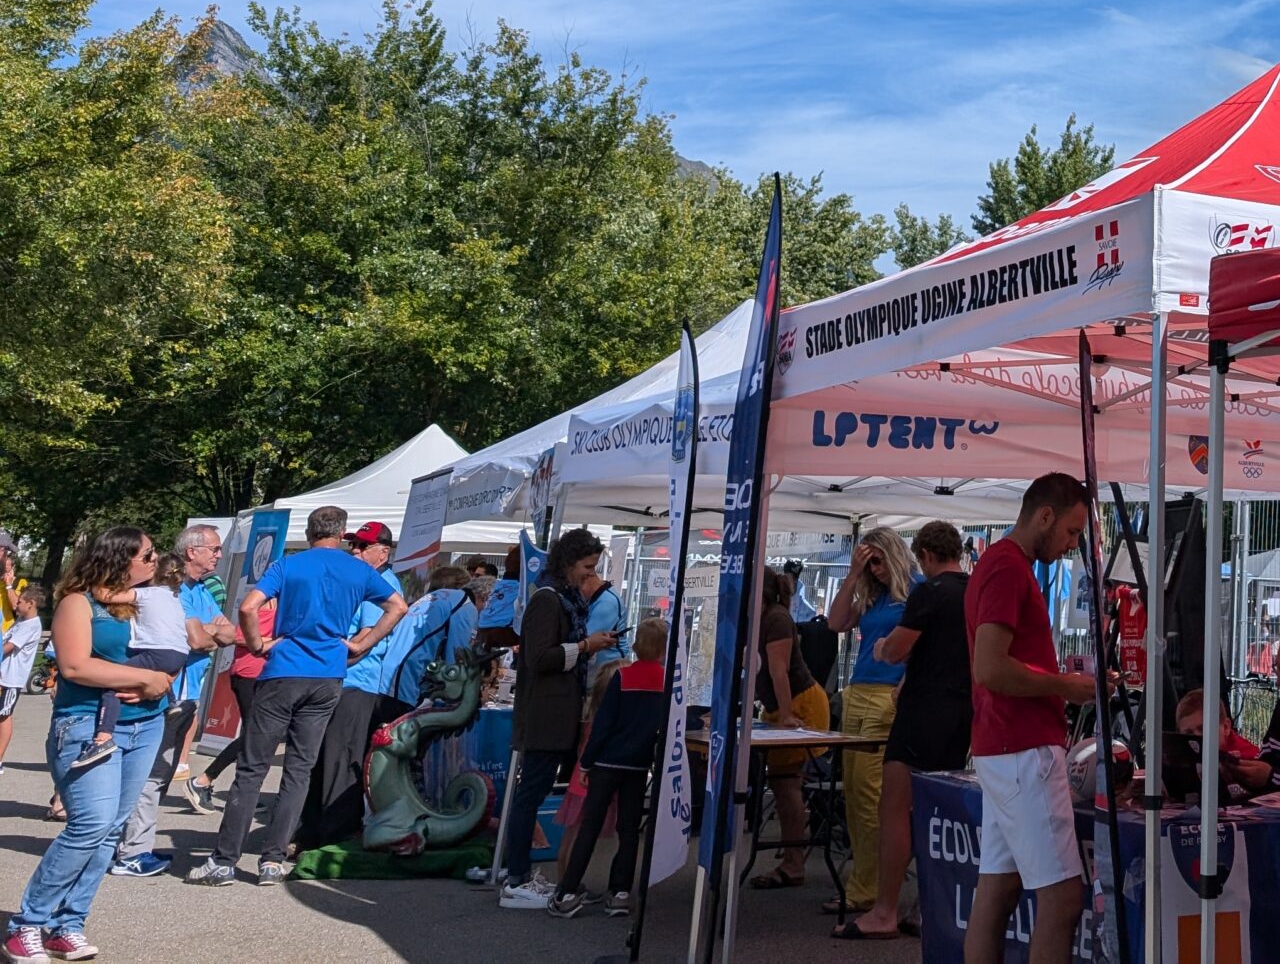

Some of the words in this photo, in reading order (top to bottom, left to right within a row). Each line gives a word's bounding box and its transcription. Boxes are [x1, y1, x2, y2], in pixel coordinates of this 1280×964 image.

[1098, 238, 1118, 252] SAVOIE
[805, 317, 843, 359] STADE
[845, 292, 918, 347] OLYMPIQUE
[920, 278, 966, 325] UGINE
[966, 245, 1078, 312] ALBERTVILLE
[571, 430, 587, 455] SKI
[586, 427, 611, 453] CLUB
[612, 416, 674, 449] OLYMPIQUE
[684, 575, 714, 589] BERTVILLE
[929, 807, 980, 865] ÉCOL
[1180, 823, 1225, 835] ECE
[1181, 838, 1194, 846] DE
